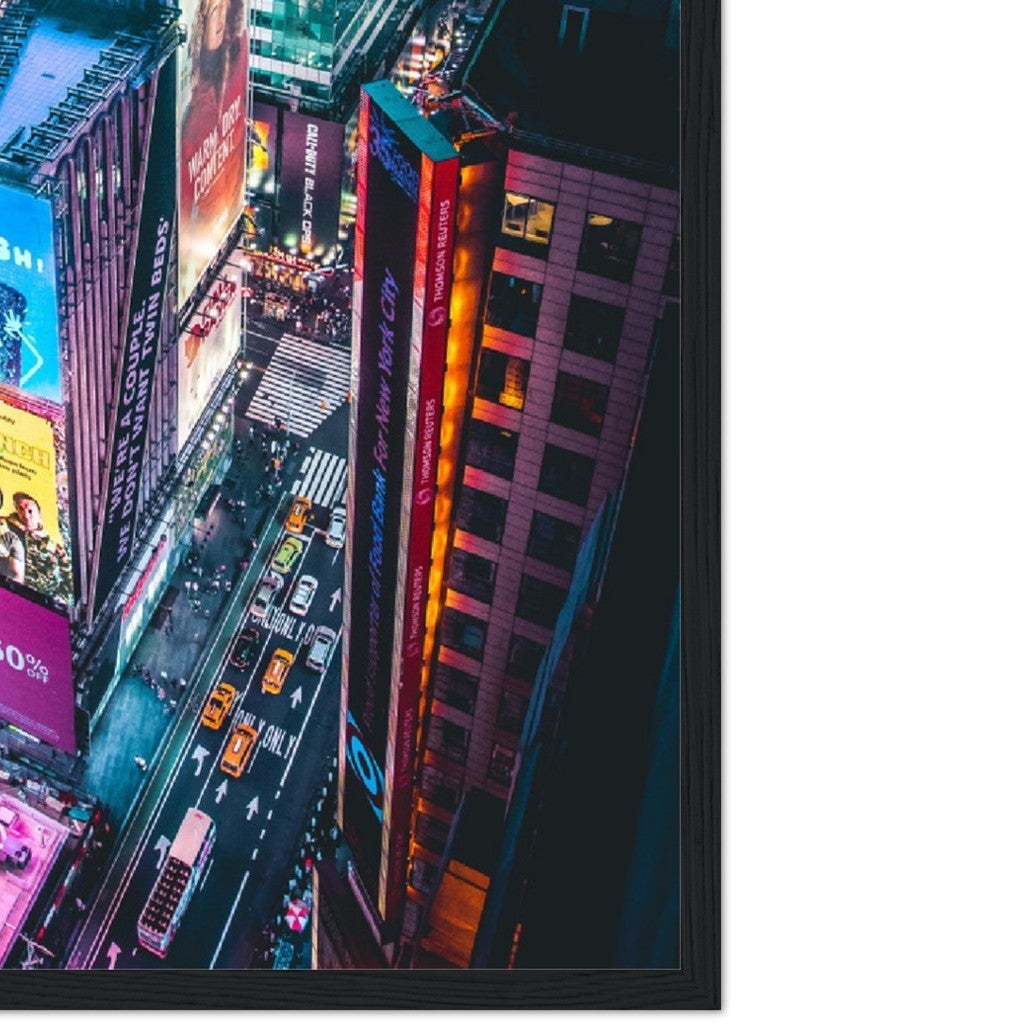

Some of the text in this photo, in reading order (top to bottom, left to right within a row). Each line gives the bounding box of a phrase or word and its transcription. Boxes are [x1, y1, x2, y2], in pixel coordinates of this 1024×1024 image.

[302, 176, 315, 218] BLACK
[301, 219, 313, 245] OPS
[434, 199, 451, 303] THOMSON REUTERS
[380, 266, 401, 323] City
[141, 291, 161, 361] TWIN
[378, 320, 394, 377] York
[109, 300, 146, 524] "WE'RE A COUPLE.
[131, 368, 150, 441] WANT
[376, 376, 391, 434] New
[421, 398, 436, 485] THOMSON REUTERS
[121, 445, 140, 519] DON'T
[117, 520, 131, 564] WE
[263, 725, 297, 760] ONLY
